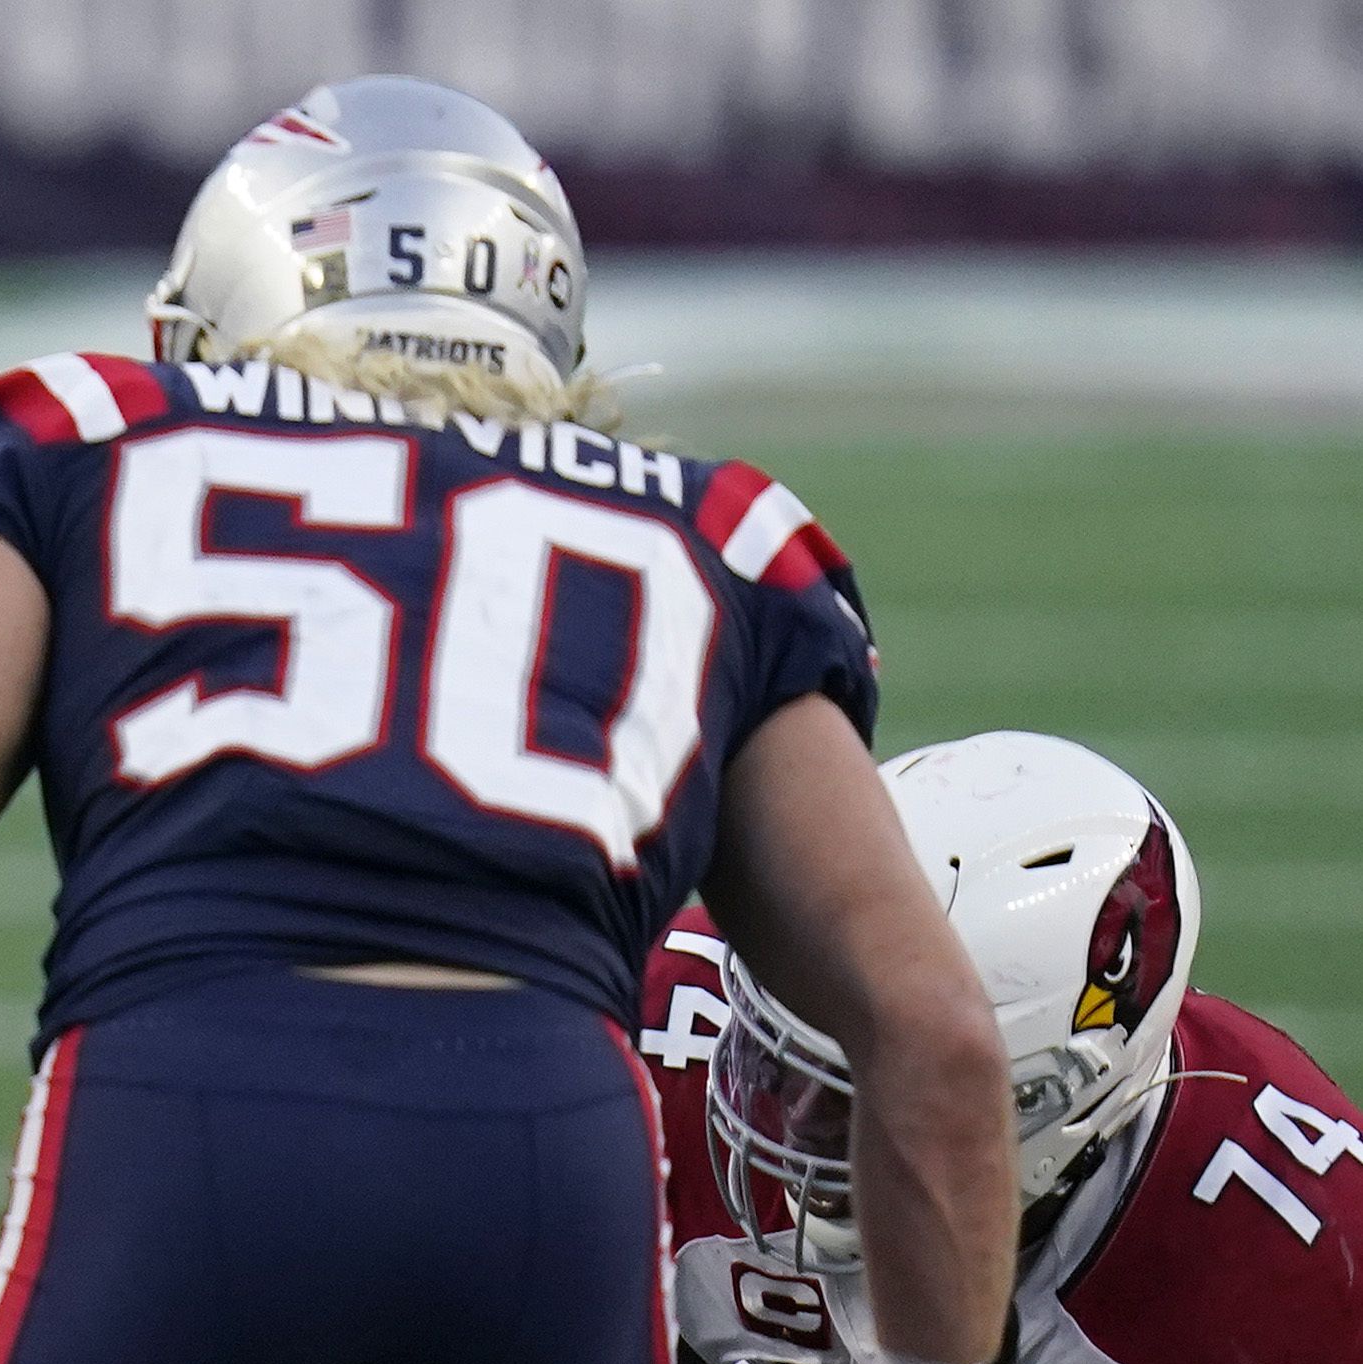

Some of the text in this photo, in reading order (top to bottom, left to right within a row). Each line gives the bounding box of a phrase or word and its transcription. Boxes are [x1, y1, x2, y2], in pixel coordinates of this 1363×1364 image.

[182, 358, 685, 509] WINVICH
[105, 425, 719, 878] 50
[1192, 1082, 1363, 1247] 74
[739, 1271, 822, 1333] C
